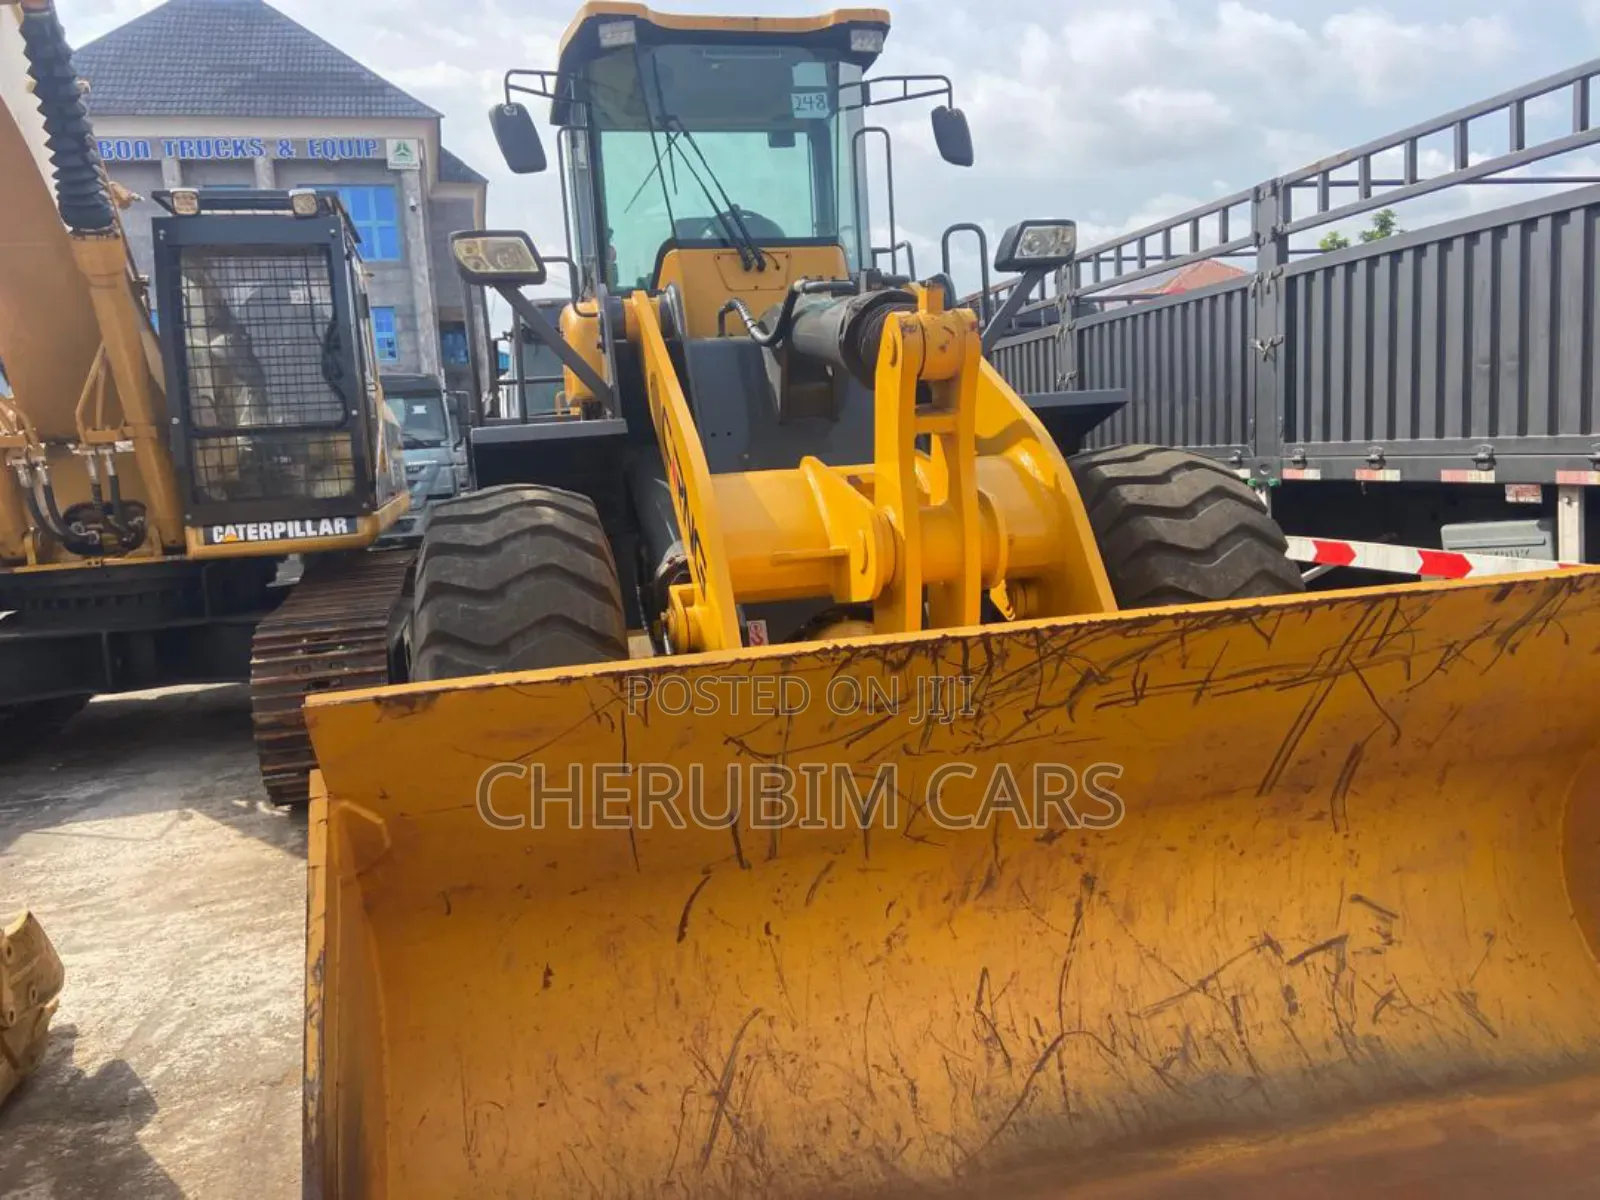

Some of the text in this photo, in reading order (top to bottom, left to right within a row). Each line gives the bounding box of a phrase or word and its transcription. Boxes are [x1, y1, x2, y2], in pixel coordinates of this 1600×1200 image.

[793, 94, 827, 113] 248
[162, 137, 266, 160] TRUCKS
[277, 138, 297, 159] &
[307, 137, 377, 161] EQUIP
[211, 516, 349, 543] CATERPILLAR
